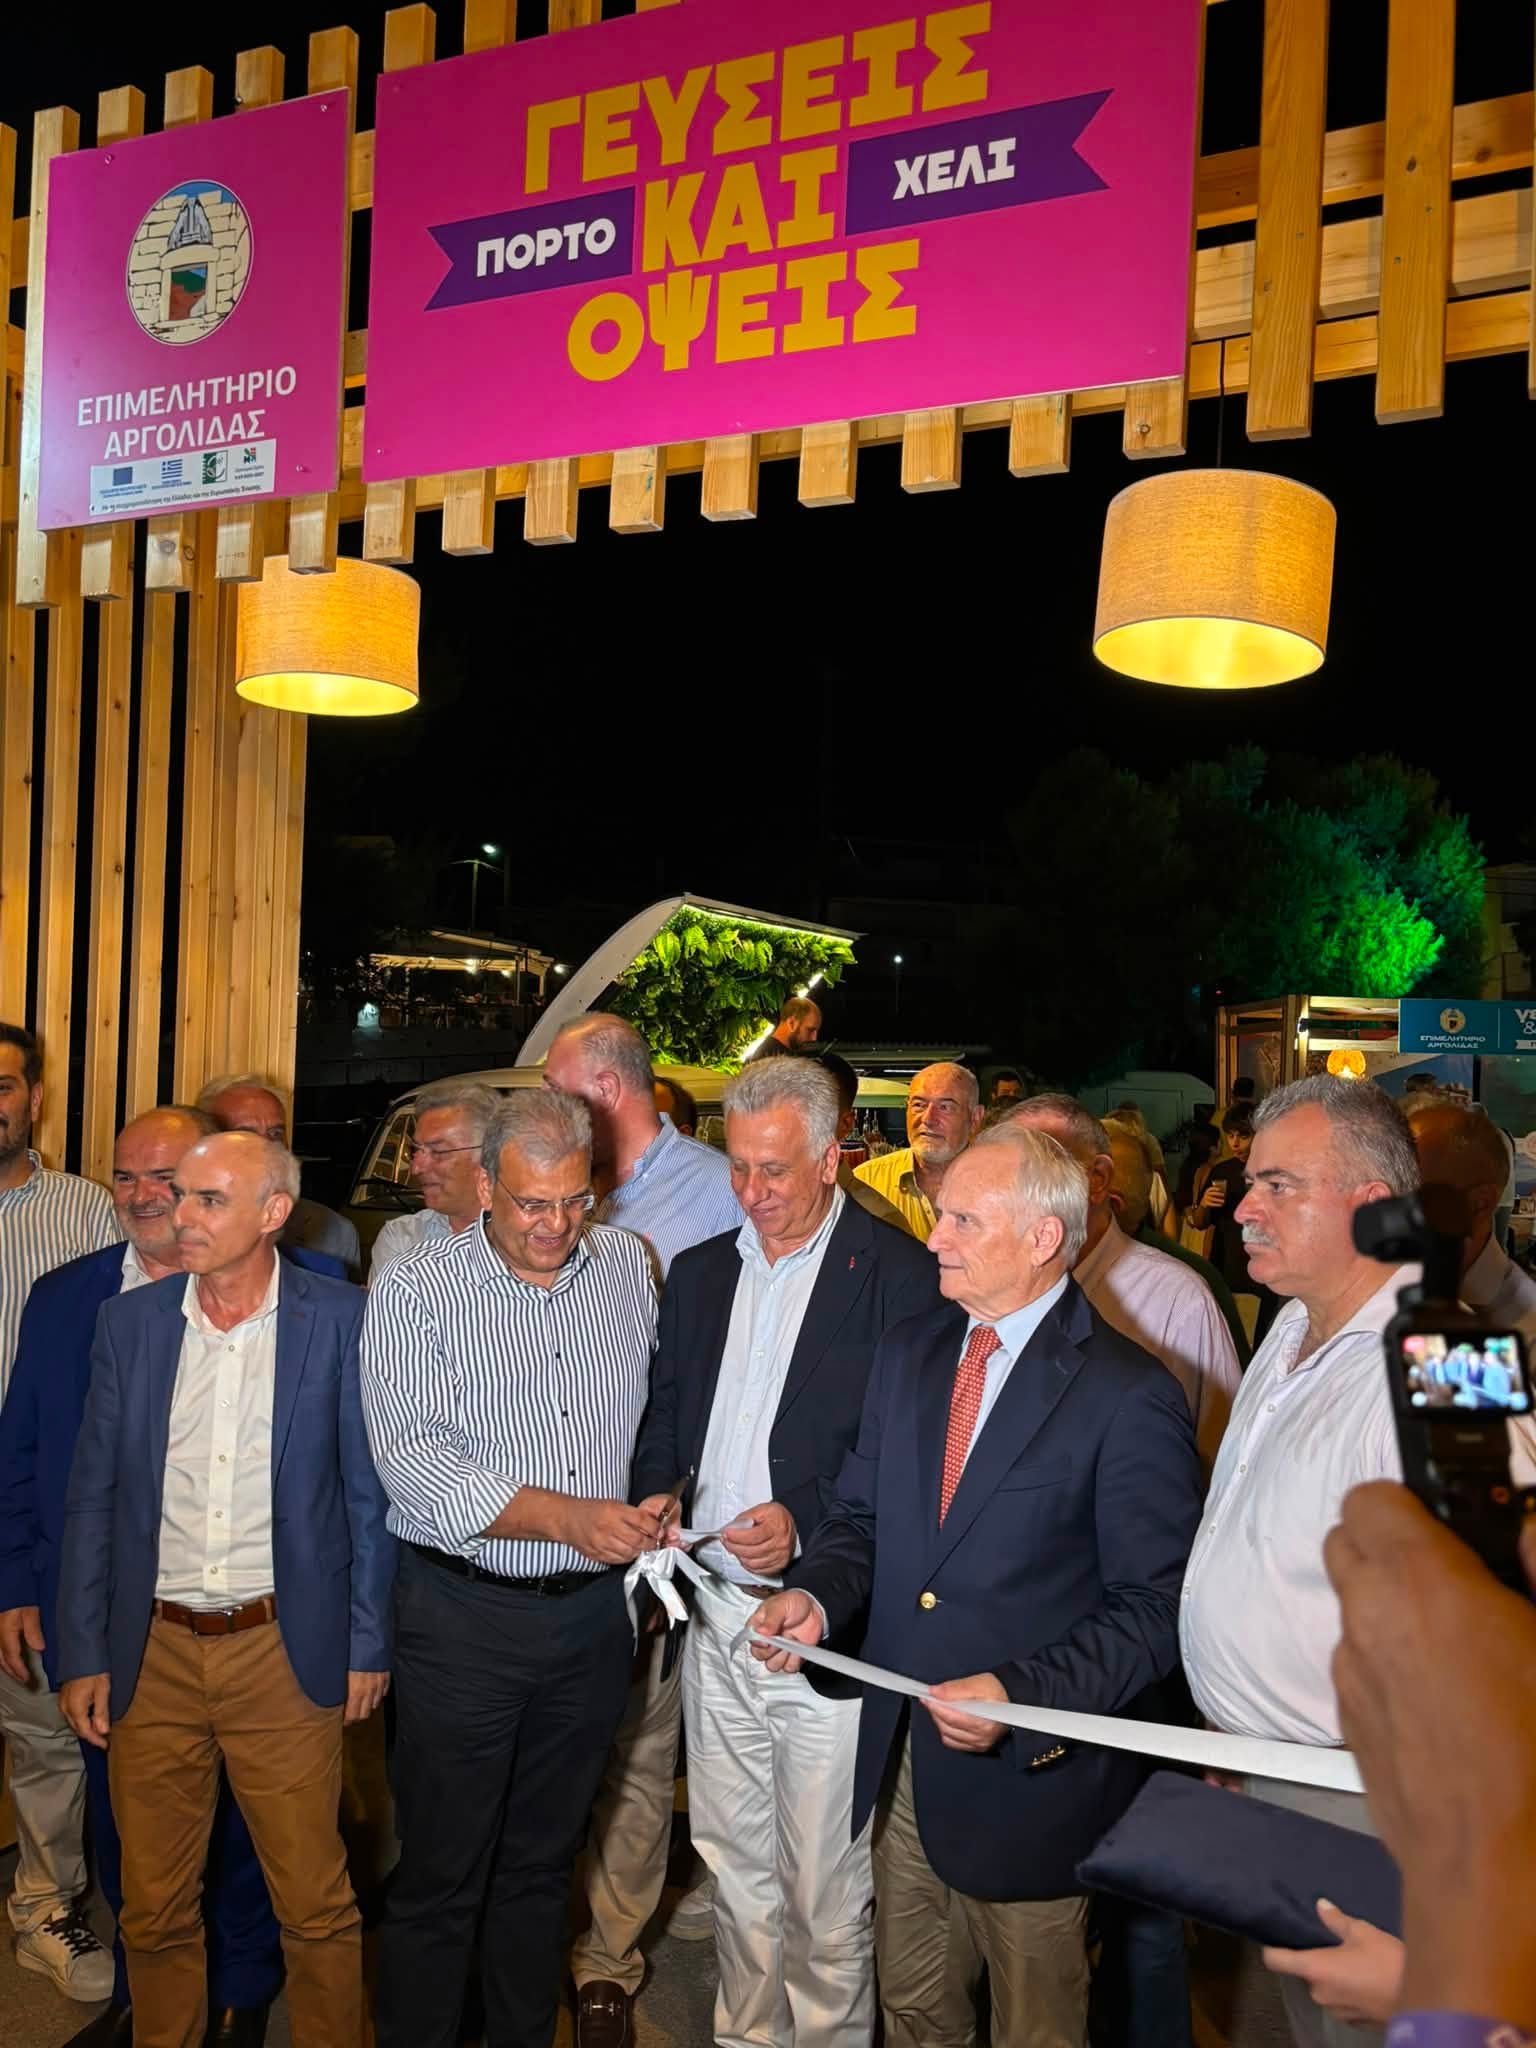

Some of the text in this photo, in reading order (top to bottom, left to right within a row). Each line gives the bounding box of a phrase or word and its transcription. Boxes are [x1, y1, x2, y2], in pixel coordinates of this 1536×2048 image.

[523, 2, 992, 194] ΓΕΥΣΕΙΣ
[475, 137, 1017, 277] ΠΟΡΤΟ ΧΕΛΙ
[641, 145, 838, 273] ΚΑΙ
[566, 238, 920, 382] ΟΨΕΙΣ
[77, 365, 297, 427] ΕΠΙΜΕΛΗΤΗΡΙΟ
[103, 409, 266, 460] ΑΡΓΟΛΙΔΑΣ
